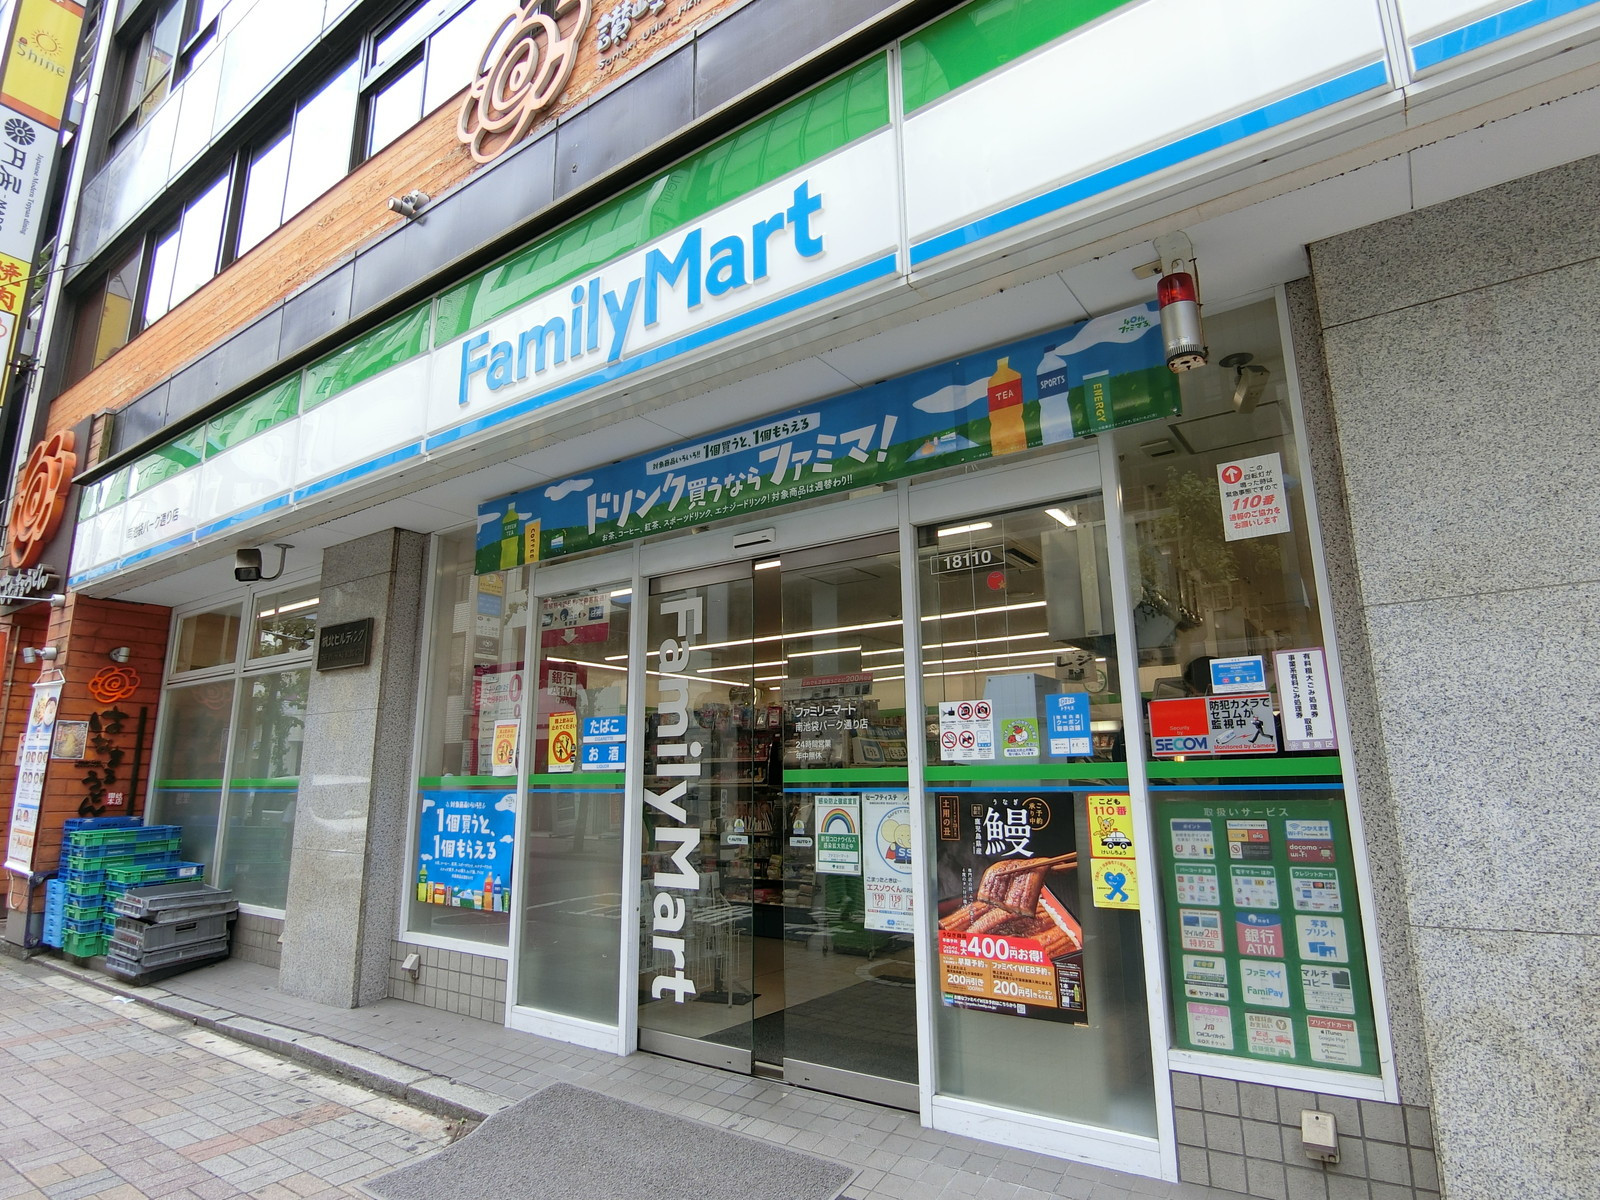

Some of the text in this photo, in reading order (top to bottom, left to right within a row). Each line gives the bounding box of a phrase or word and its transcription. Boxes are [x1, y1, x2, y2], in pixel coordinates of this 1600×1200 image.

[642, 16, 674, 41] Udon
[16, 42, 66, 78] Shine
[458, 179, 828, 408] FamilyMart
[1040, 374, 1066, 389] SPORTS
[995, 389, 1014, 401] TEA
[1093, 383, 1107, 423] ENERGY
[1244, 469, 1272, 480] 回転灯が
[1239, 477, 1273, 488] 鳴った時は
[1225, 483, 1278, 498] 緊急事態ですので
[1232, 494, 1275, 511] 110番
[1229, 507, 1281, 521] 通報のご協力を
[1234, 515, 1278, 529] お願いします
[943, 550, 992, 570] 18110
[1057, 655, 1092, 667] レジ
[551, 670, 574, 685] 銀行
[551, 685, 573, 697] ATM
[1302, 653, 1319, 718] 有料粗大ごみ処理券
[795, 703, 856, 718] ファミリーマート
[1209, 698, 1270, 711] 防犯カメラで
[1211, 708, 1253, 720] セコムが
[590, 719, 619, 734] たばこ
[795, 718, 869, 733] 南池袋パーク通り店
[1211, 718, 1246, 729] 監視中
[1304, 718, 1314, 738] 取扱所
[795, 739, 832, 749] 24時間営業
[1155, 737, 1207, 751] SECOM
[588, 746, 619, 761] お酒
[795, 752, 823, 760] 年中無休
[643, 596, 703, 1004] FamilyMart
[818, 797, 857, 805] 感染防止徹底宣言
[992, 798, 1019, 806] うなぎ
[942, 799, 951, 836] 土用の丑
[1028, 803, 1036, 824] 承り中
[1093, 806, 1127, 816] 110番
[1203, 807, 1290, 817] 取扱いサービス
[437, 808, 496, 836] 1個買うと、
[974, 818, 982, 855] 鹿児島県産
[983, 806, 1034, 857] 鰻
[434, 834, 497, 860] 1個もらえる
[823, 842, 854, 850] 感染拡大防止中
[1311, 919, 1328, 928] 写真
[1183, 928, 1219, 939] マイルが2倍
[1244, 928, 1275, 944] 銀行
[1305, 928, 1336, 938] プリント
[960, 939, 967, 956] 最大
[1189, 938, 1215, 948] 特約店
[1246, 943, 1276, 956] ATM
[947, 973, 984, 986] 200円引き
[1245, 968, 1281, 979] ファミペイ
[1302, 969, 1329, 978] マルチ
[993, 979, 1038, 999] 200円引き
[1303, 978, 1331, 987] コピー
[1199, 990, 1225, 998] ヤマト運輸
[1247, 986, 1284, 999] FamiPay
[1249, 1015, 1273, 1023] 各種料金
[1310, 1020, 1353, 1029] プリペイドカード
[1251, 1036, 1275, 1044] サービス
